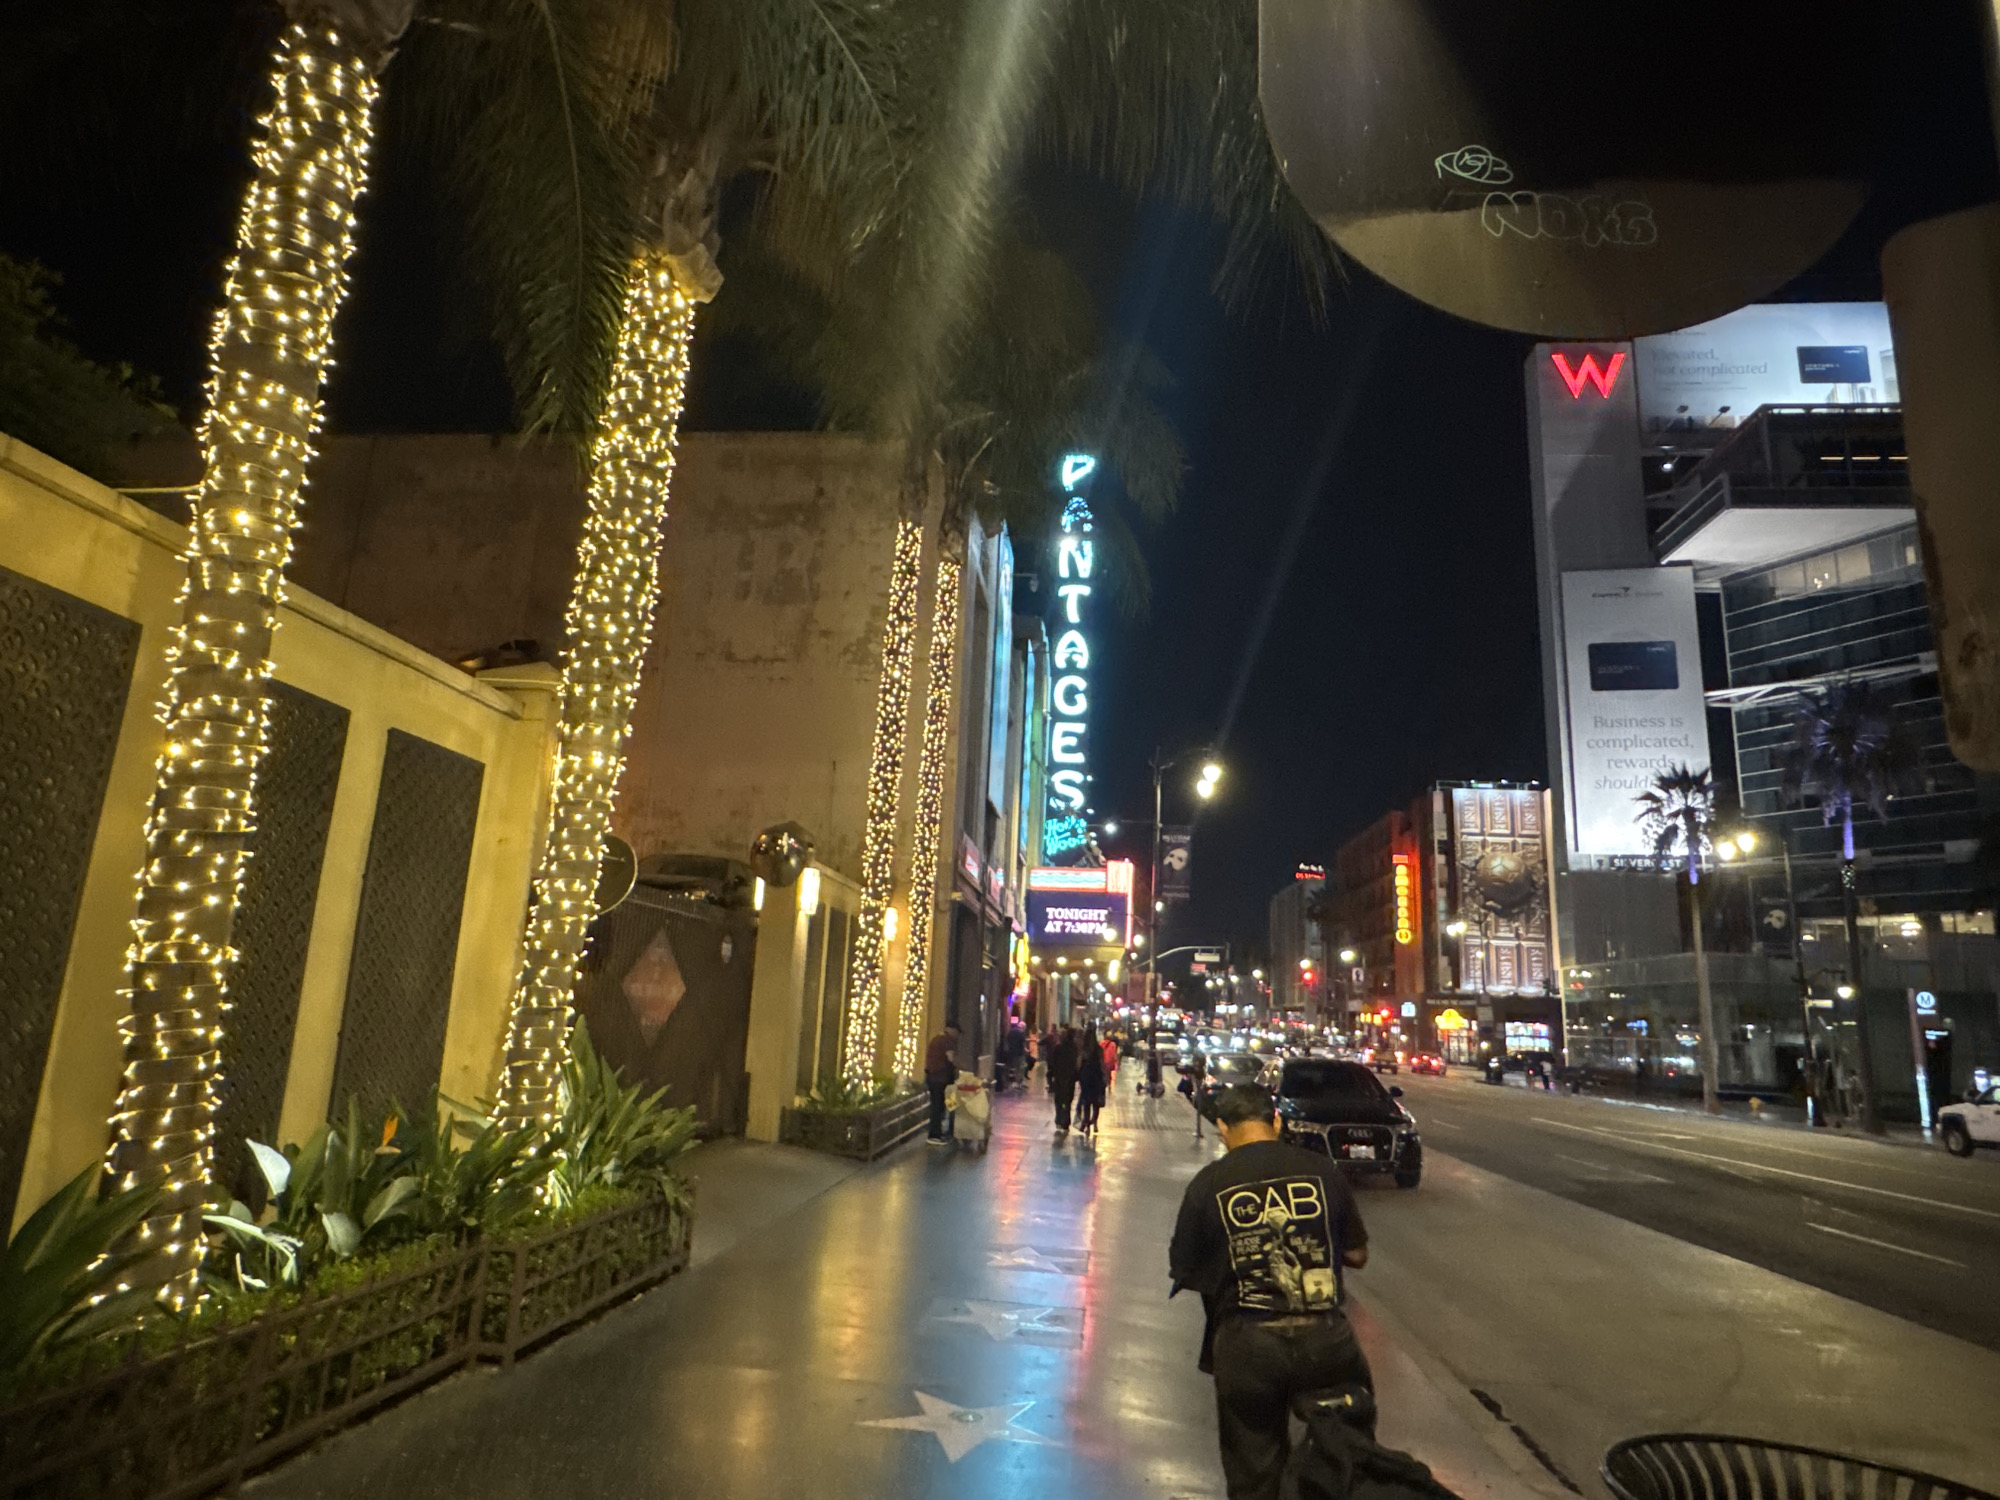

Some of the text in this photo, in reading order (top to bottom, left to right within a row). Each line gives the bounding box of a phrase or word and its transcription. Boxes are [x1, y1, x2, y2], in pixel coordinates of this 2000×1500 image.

[1551, 352, 1626, 399] W
[1049, 453, 1097, 809] PANTAGES
[1593, 716, 1683, 728] Business is
[1586, 734, 1694, 751] complicated,
[1046, 907, 1108, 921] TONIGHT
[1044, 920, 1063, 933] AT
[1227, 1182, 1322, 1227] CAB
[1233, 1202, 1257, 1218] THE
